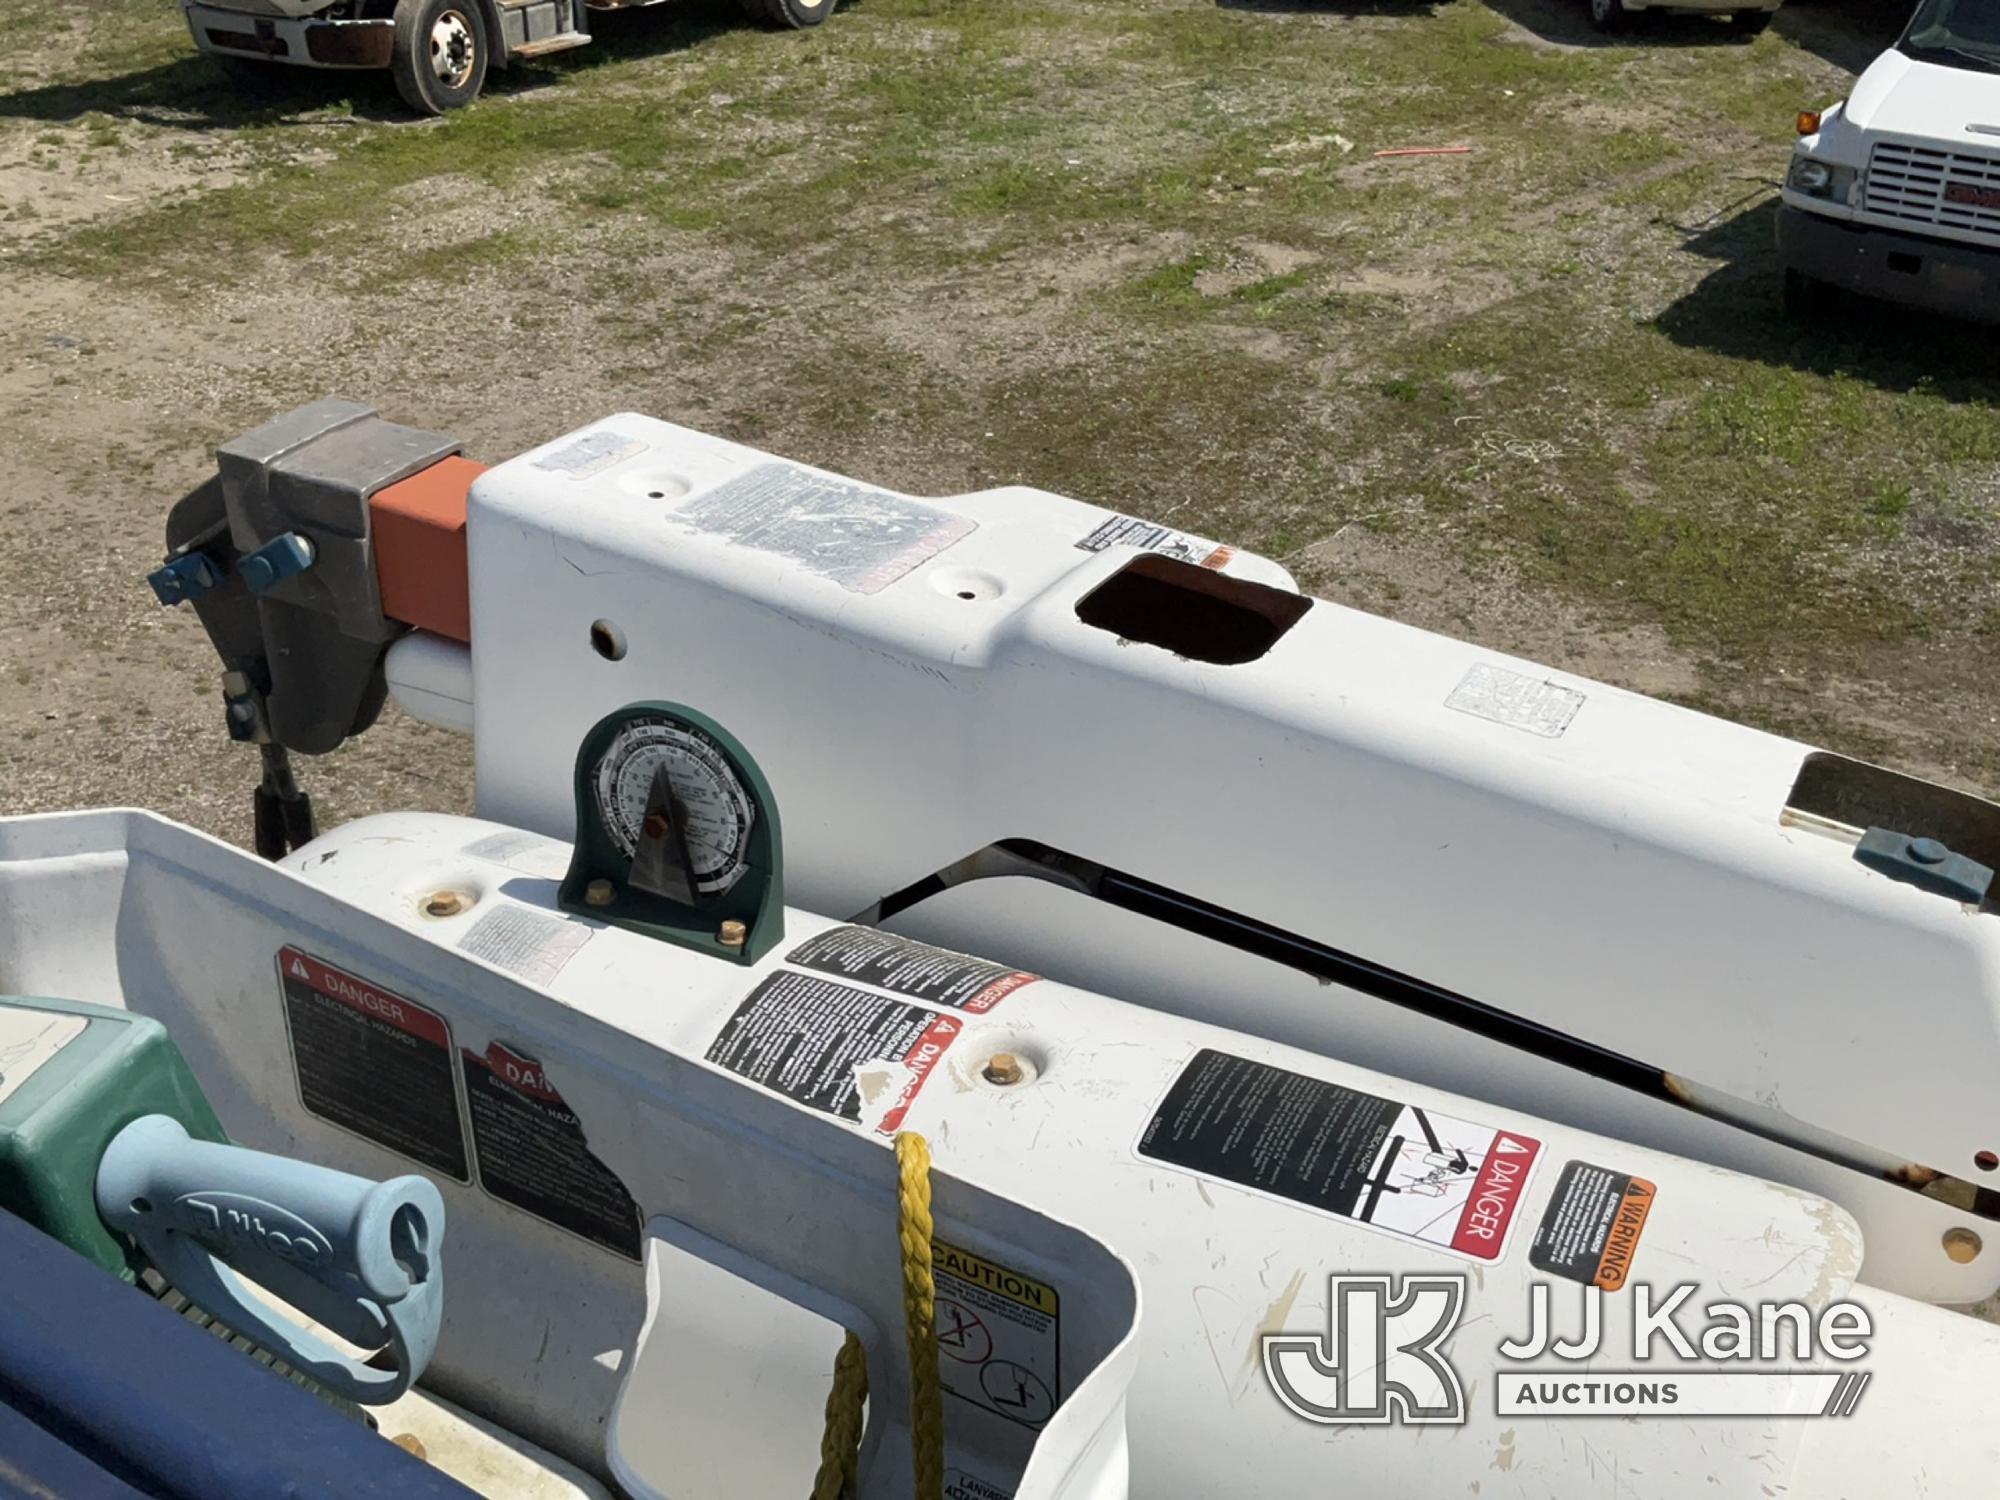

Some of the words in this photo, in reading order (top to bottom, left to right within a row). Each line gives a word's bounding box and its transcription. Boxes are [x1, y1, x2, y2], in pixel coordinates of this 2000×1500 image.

[325, 973, 406, 1023] DANGER
[896, 1011, 936, 1053] OPERATION
[547, 1106, 580, 1127] HAZA
[1465, 1157, 1518, 1241] DANGER
[1600, 1191, 1619, 1224] ELECTRICAL
[1589, 1223, 1606, 1253] HAZARDS
[1599, 1200, 1644, 1282] WARNING
[932, 1246, 1041, 1306] CAUTION
